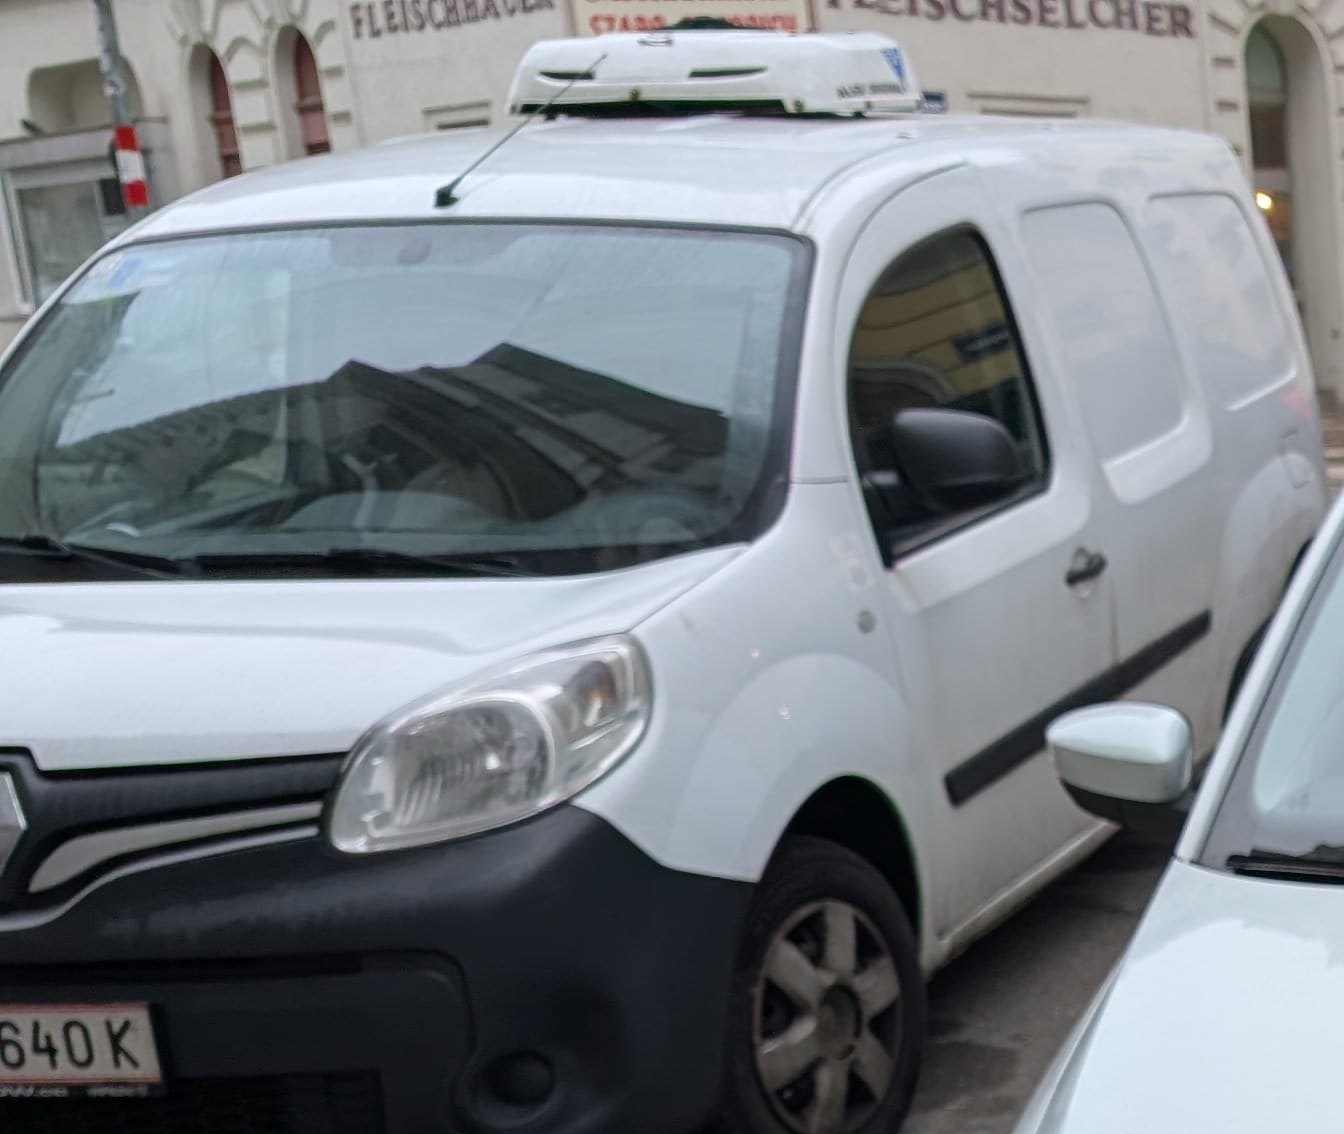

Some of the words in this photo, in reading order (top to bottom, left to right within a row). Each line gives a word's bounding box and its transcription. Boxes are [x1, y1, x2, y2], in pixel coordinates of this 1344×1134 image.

[827, 0, 1194, 38] ISCHSELCHER
[0, 1020, 94, 1069] 640
[105, 1020, 140, 1068] K
